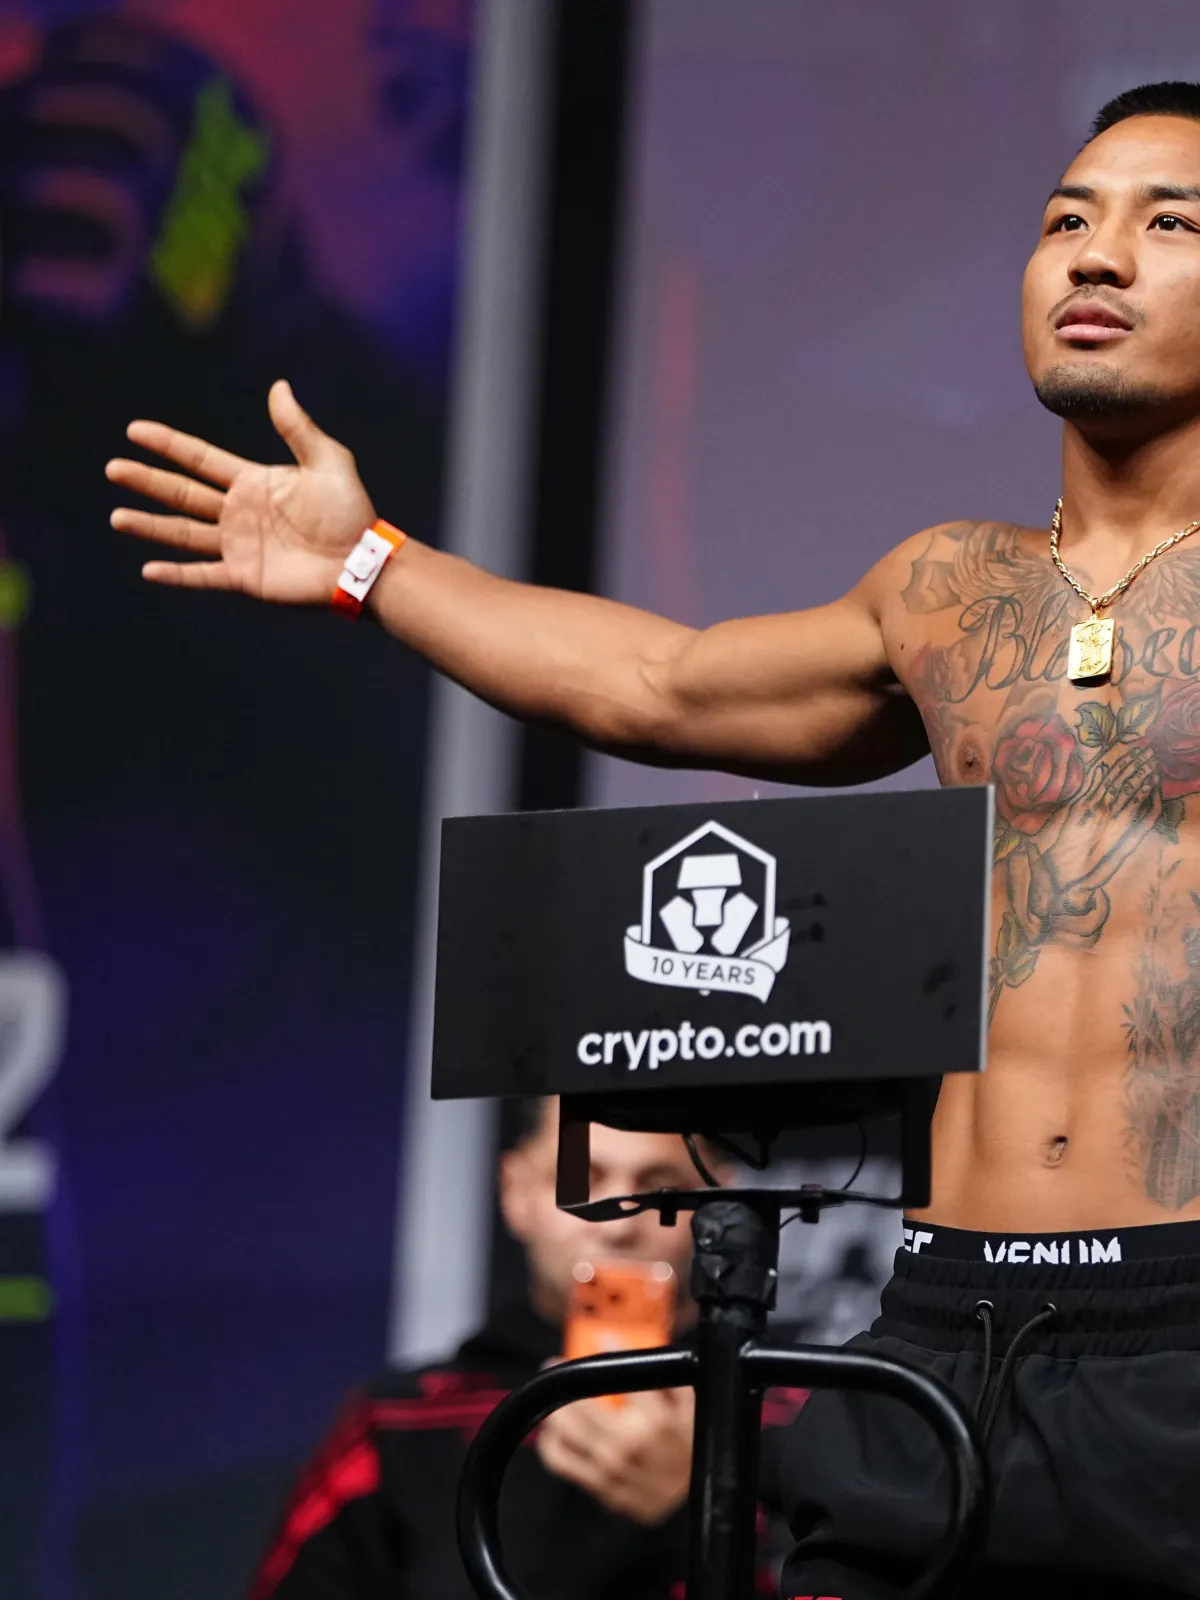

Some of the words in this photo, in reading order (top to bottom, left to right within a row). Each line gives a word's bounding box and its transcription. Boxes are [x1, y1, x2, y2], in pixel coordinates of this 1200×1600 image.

[652, 956, 674, 975] 10
[682, 960, 756, 985] YEARS
[577, 1020, 832, 1070] crypto.com
